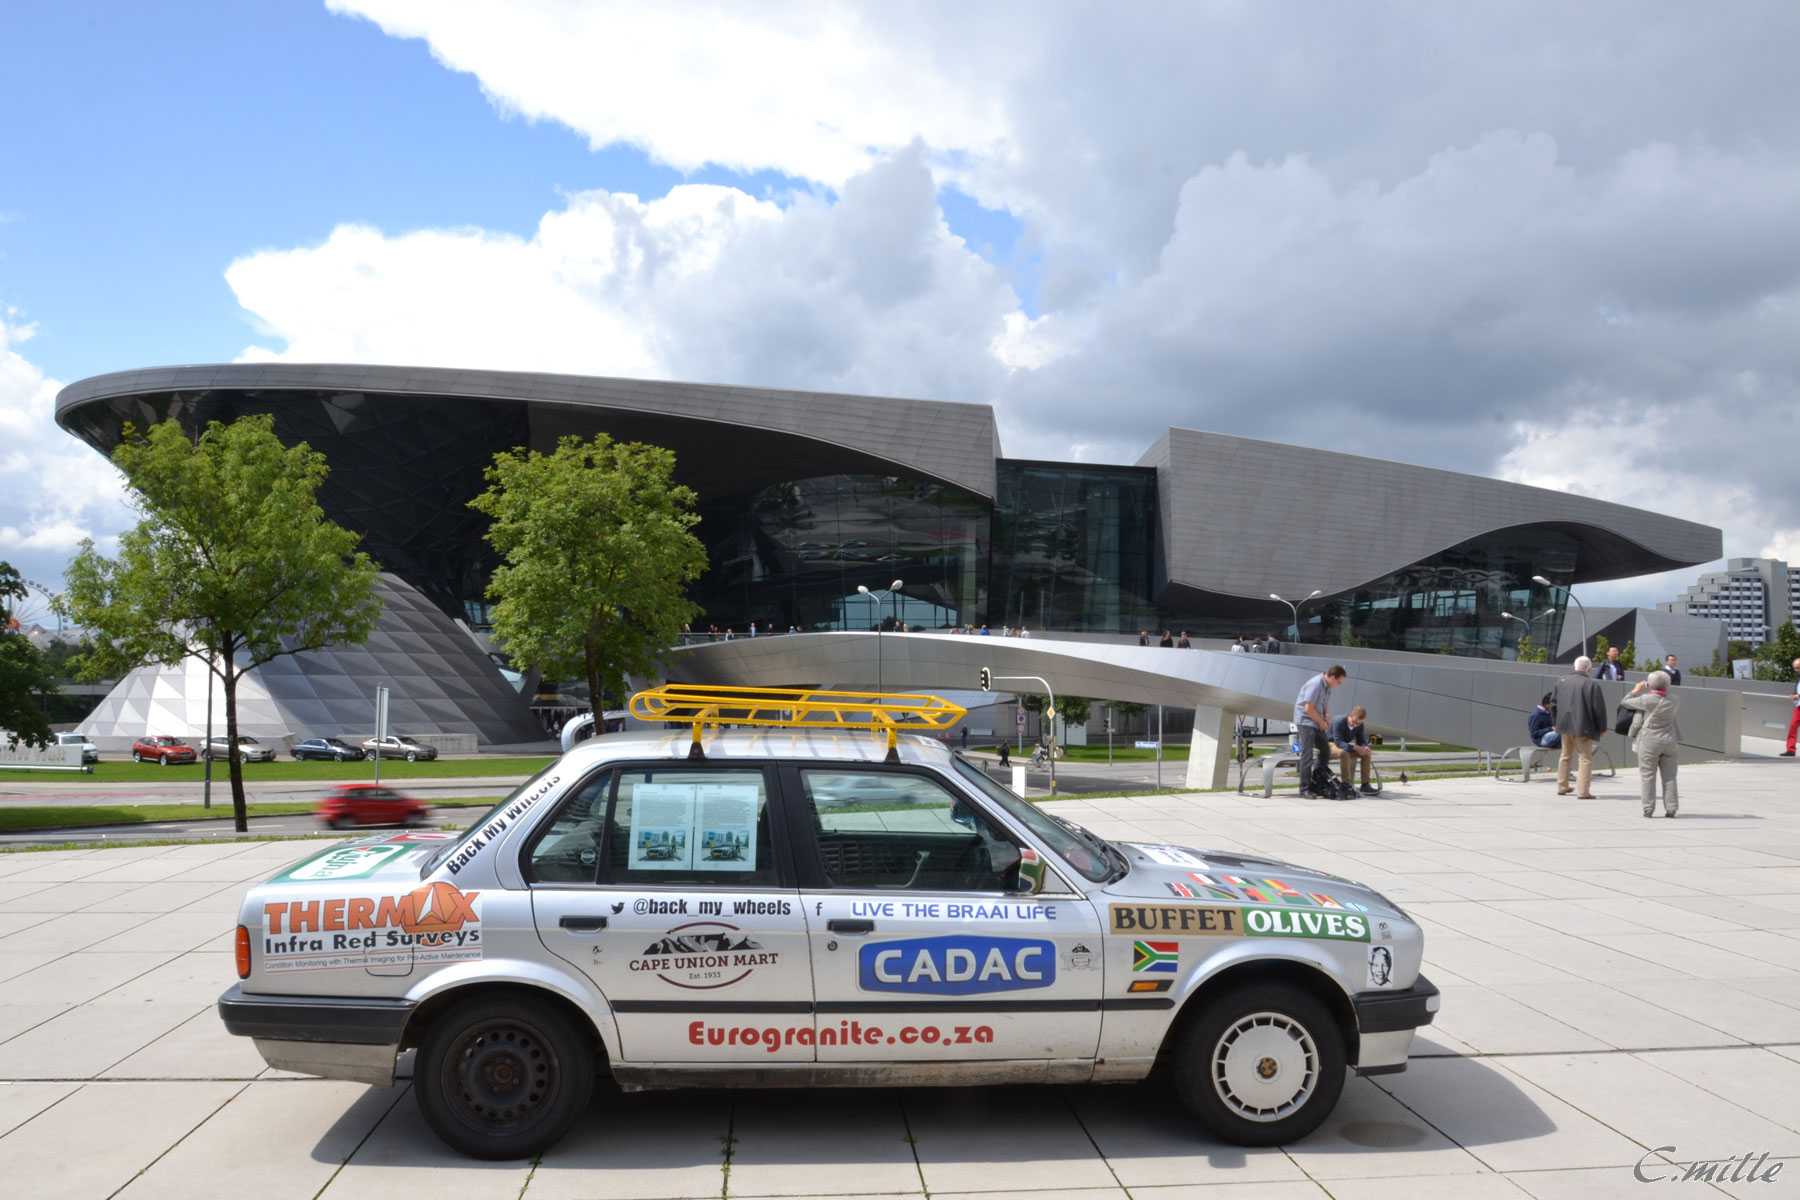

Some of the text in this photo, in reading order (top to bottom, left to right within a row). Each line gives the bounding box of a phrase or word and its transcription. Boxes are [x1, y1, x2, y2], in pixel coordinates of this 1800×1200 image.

[446, 838, 486, 876] Back
[481, 818, 508, 841] My
[633, 898, 791, 917] @back_my_wheels
[851, 902, 1057, 920] LIVE THE BRAAI LIFE
[1113, 906, 1236, 931] BUFFET
[1246, 910, 1367, 938] OLIVES
[265, 929, 480, 954] Infra Red Surveys
[629, 952, 779, 972] CAPE UNION MART
[873, 946, 1043, 984] CADAC
[688, 1020, 994, 1053] Eurogranite.co.za
